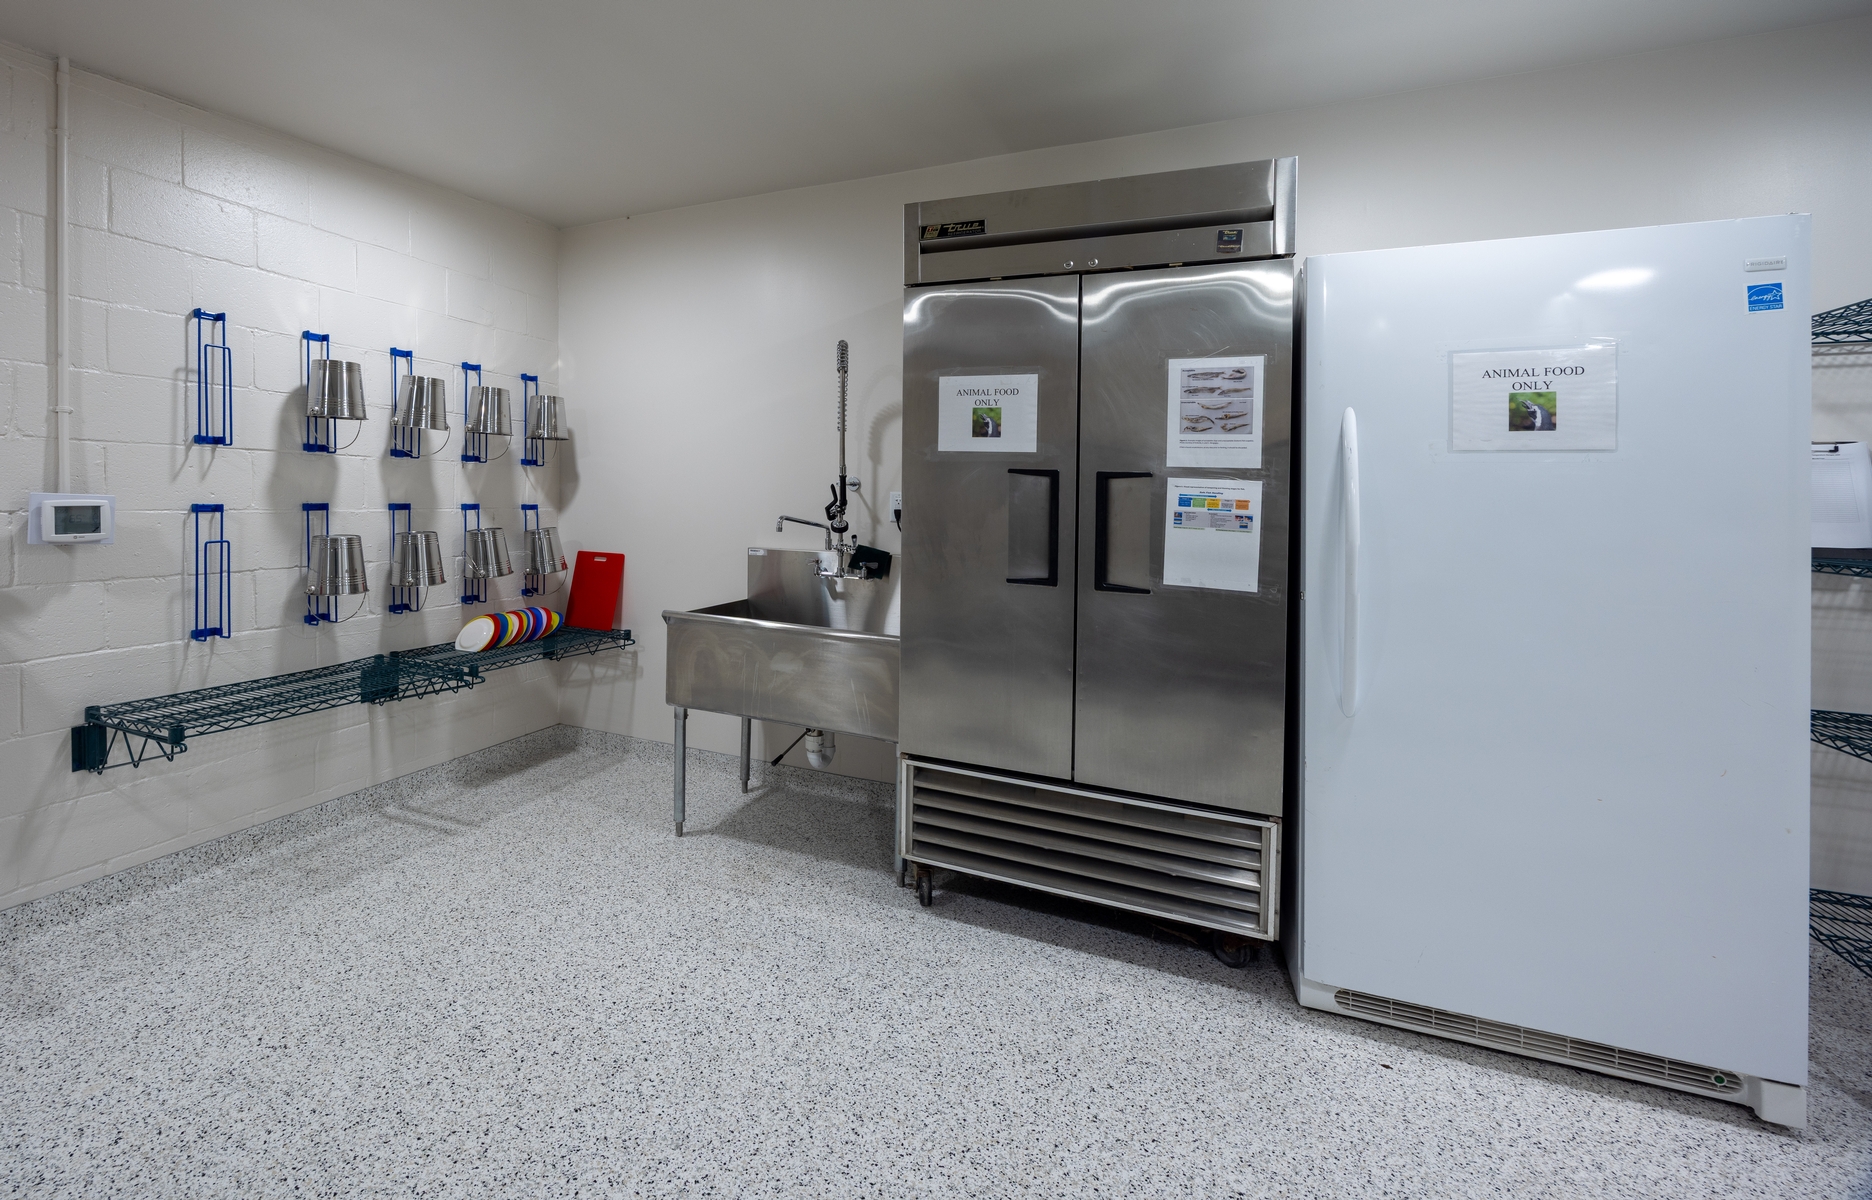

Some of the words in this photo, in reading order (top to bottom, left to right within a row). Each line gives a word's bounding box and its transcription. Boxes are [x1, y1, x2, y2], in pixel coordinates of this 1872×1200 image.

[1482, 368, 1540, 379] ANIMAL
[1544, 366, 1585, 377] FOOD
[1512, 381, 1553, 391] ONLY
[956, 388, 992, 396] ANIMAL
[994, 388, 1019, 396] FOOD
